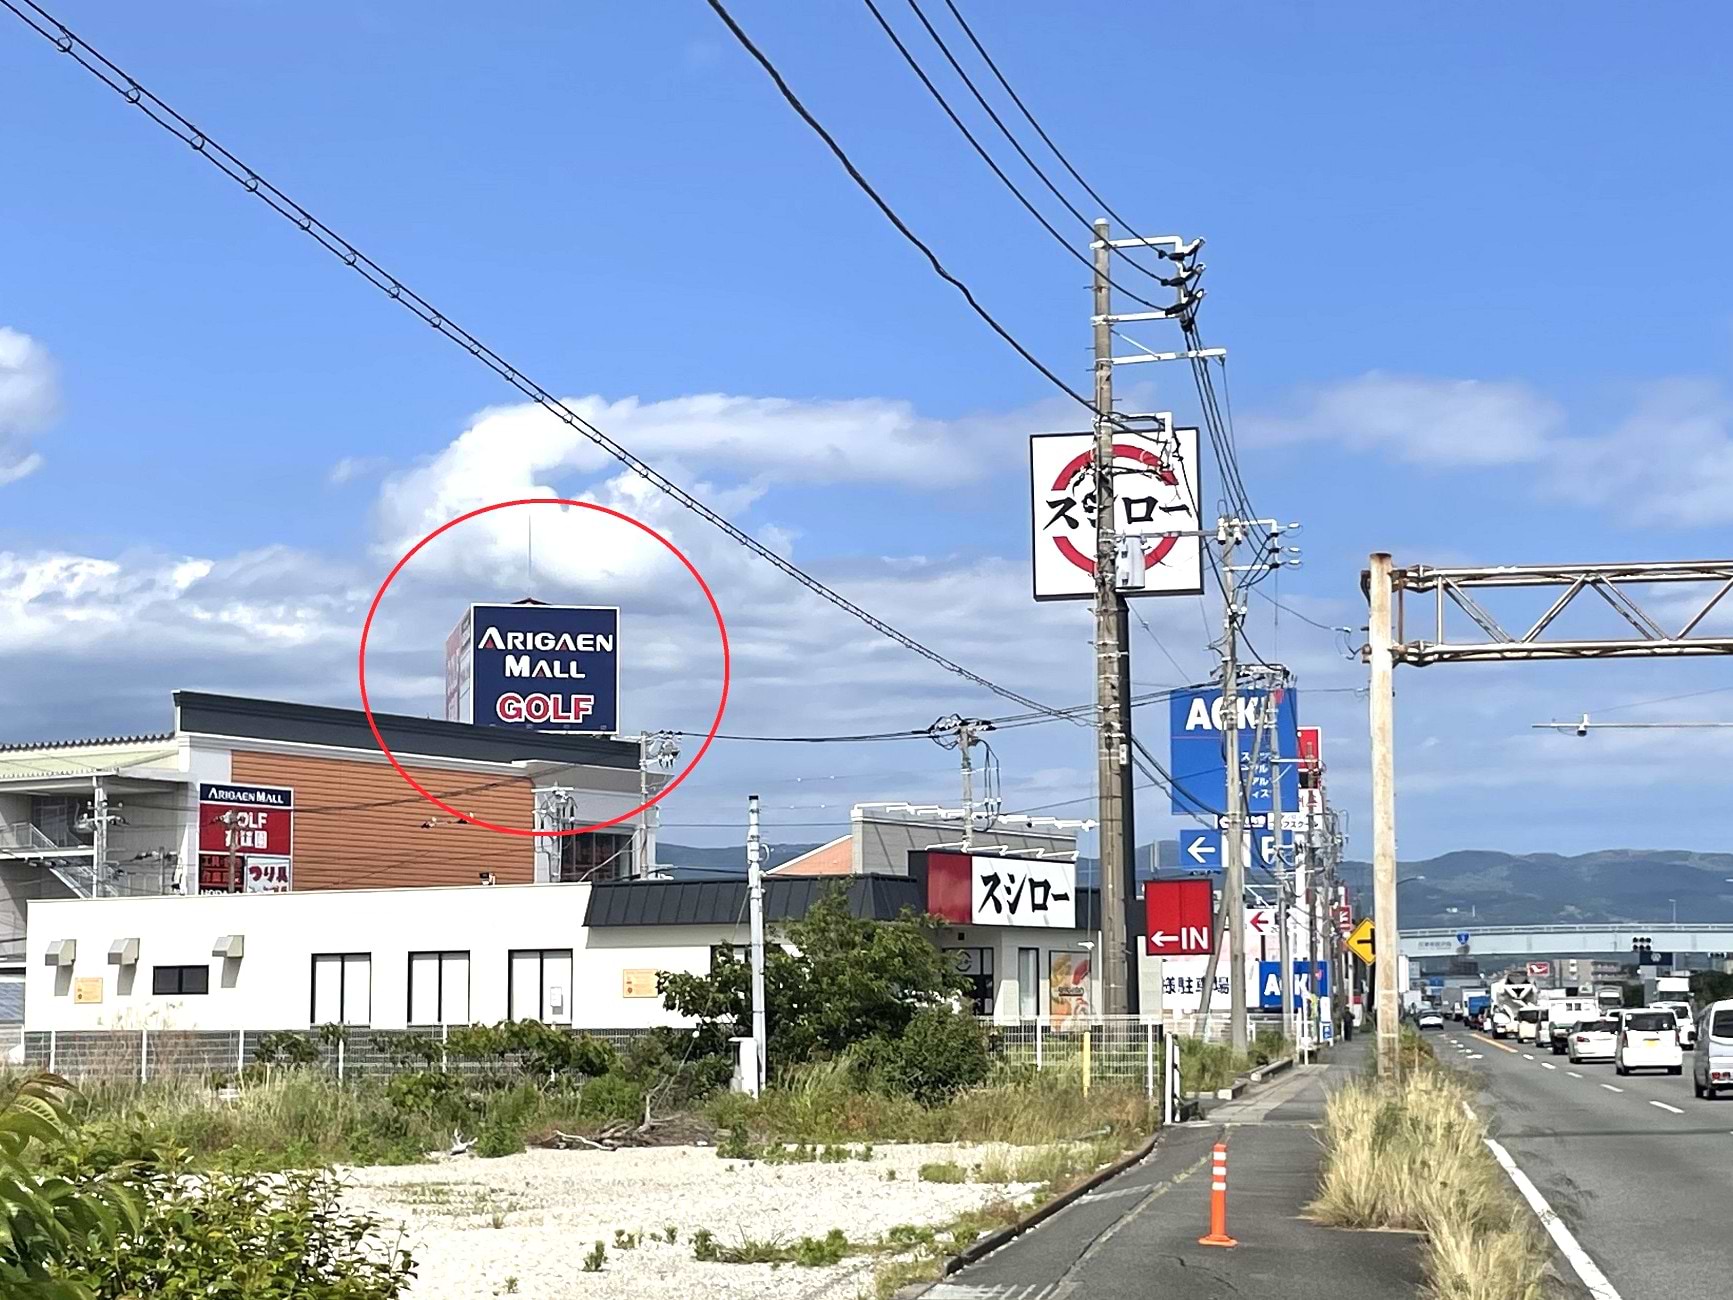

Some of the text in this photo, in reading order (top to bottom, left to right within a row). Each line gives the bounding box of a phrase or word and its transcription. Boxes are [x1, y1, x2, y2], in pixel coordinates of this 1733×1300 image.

[478, 626, 613, 652] ARIGAEN
[505, 654, 586, 679] MALL
[496, 692, 595, 723] GOLF
[978, 871, 1071, 915] スシロー
[1181, 926, 1209, 950] IN
